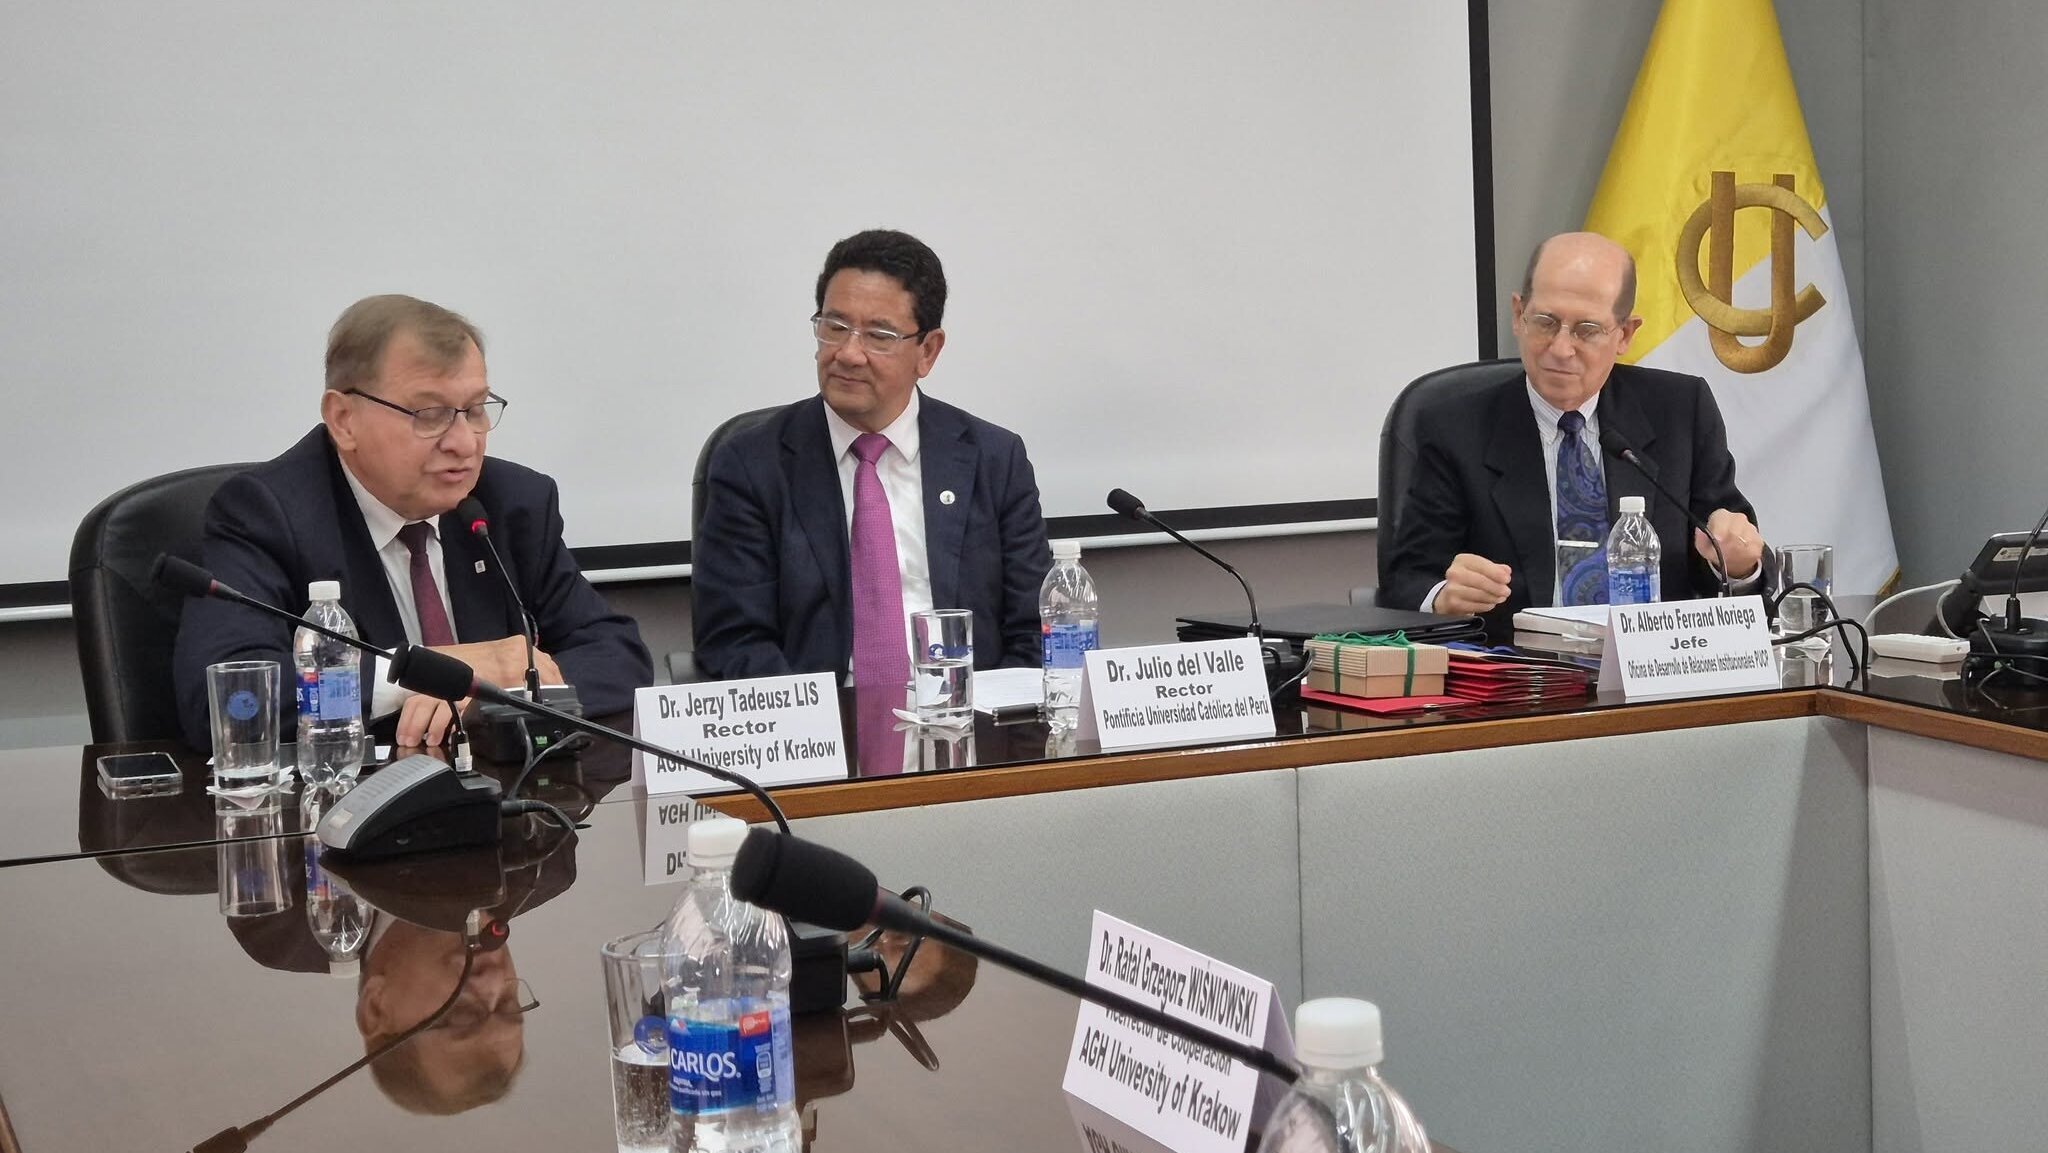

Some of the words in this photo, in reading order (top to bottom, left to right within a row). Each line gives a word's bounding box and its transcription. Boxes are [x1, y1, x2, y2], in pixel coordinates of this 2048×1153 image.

[1620, 612, 1635, 634] Dr.
[1638, 611, 1674, 633] Alberto
[1675, 608, 1714, 630] Ferrand
[1715, 605, 1756, 630] Noriega
[1670, 636, 1708, 650] Jefe
[1106, 659, 1130, 683] Dr.
[1135, 656, 1173, 680] Julio
[1177, 652, 1201, 676] del
[1203, 649, 1245, 674] Valle
[1628, 660, 1648, 678] Oficina
[1647, 659, 1655, 677] de
[1654, 657, 1682, 677] Desarrollo
[1681, 656, 1689, 675] de
[1688, 655, 1718, 673] Relaciones
[1717, 653, 1755, 671] Institucionales
[659, 694, 680, 719] Dr.
[685, 692, 724, 720] Jerzy
[728, 687, 792, 713] Tadeusz
[794, 681, 819, 706] LIS
[1156, 683, 1213, 699] Rector
[1103, 706, 1145, 730] Pontificia
[1147, 702, 1197, 726] Universidad
[1197, 699, 1233, 721] Católica
[1234, 697, 1248, 717] del
[1250, 695, 1269, 716] Perú
[703, 720, 777, 738] Rector
[766, 741, 780, 763] of
[783, 738, 837, 761] Krakow
[1099, 930, 1113, 975] Dr.
[1141, 947, 1187, 1013] Grzegorz
[1156, 1028, 1168, 1046] de
[1079, 1026, 1110, 1072] AGH
[1109, 1041, 1172, 1114] University
[1171, 1074, 1190, 1112] of
[1187, 1080, 1242, 1141] Krakow
